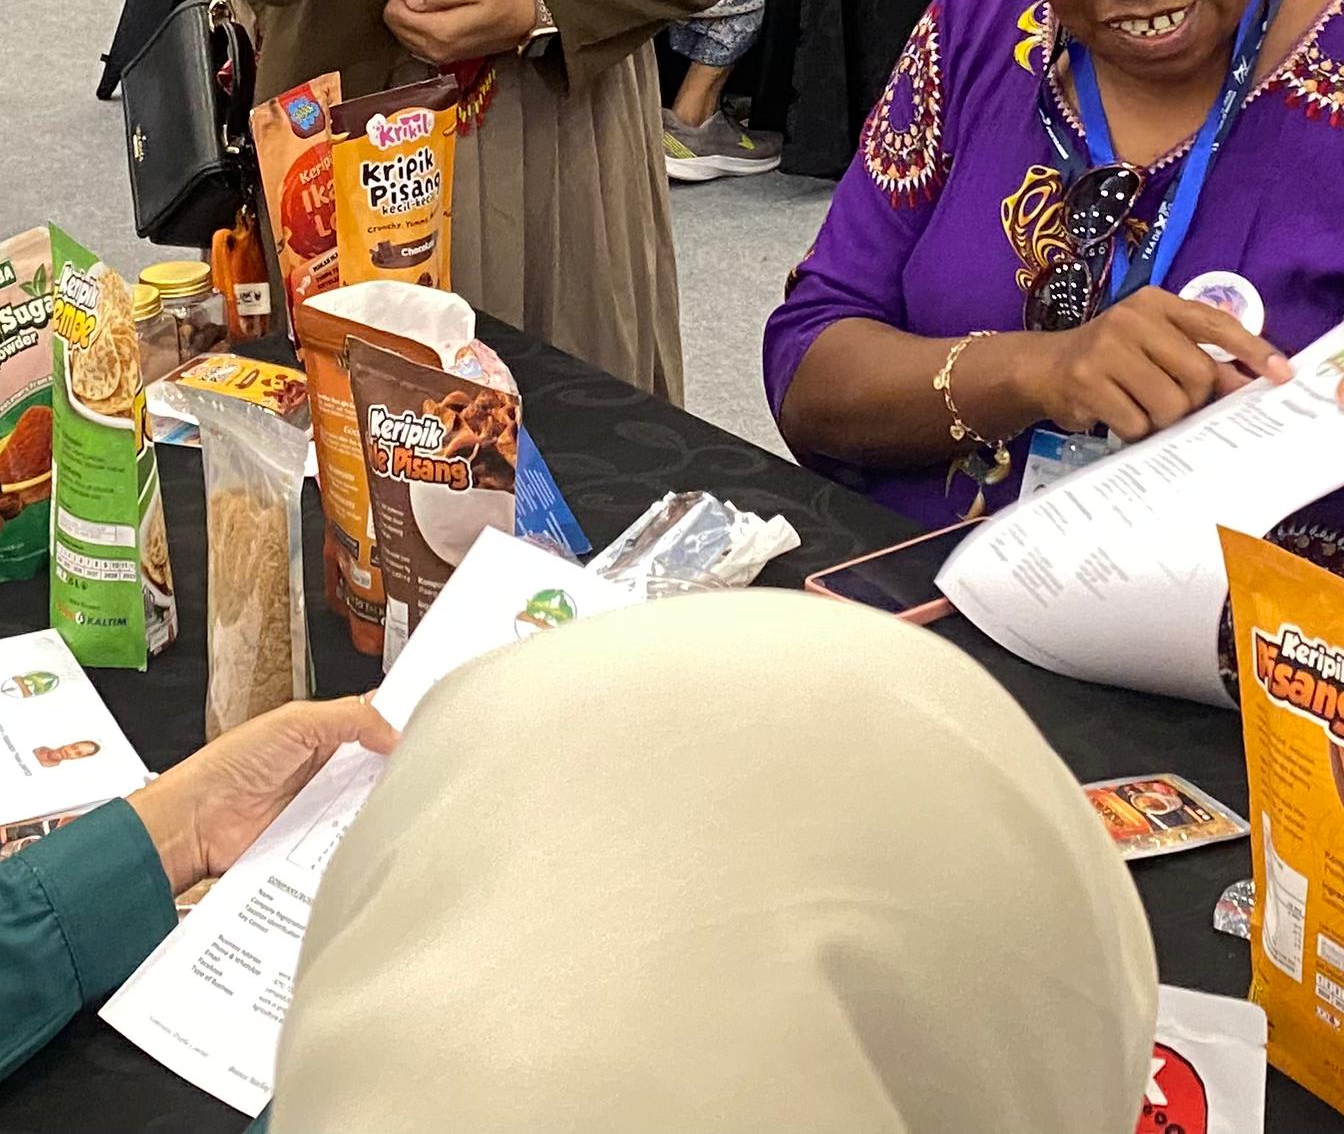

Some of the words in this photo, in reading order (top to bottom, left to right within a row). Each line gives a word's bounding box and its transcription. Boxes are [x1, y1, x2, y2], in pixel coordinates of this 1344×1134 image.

[362, 148, 434, 186] Kripik
[370, 171, 441, 207] Pisang
[53, 298, 97, 348] empe
[370, 408, 443, 449] Keripik
[393, 447, 469, 490] Pisang
